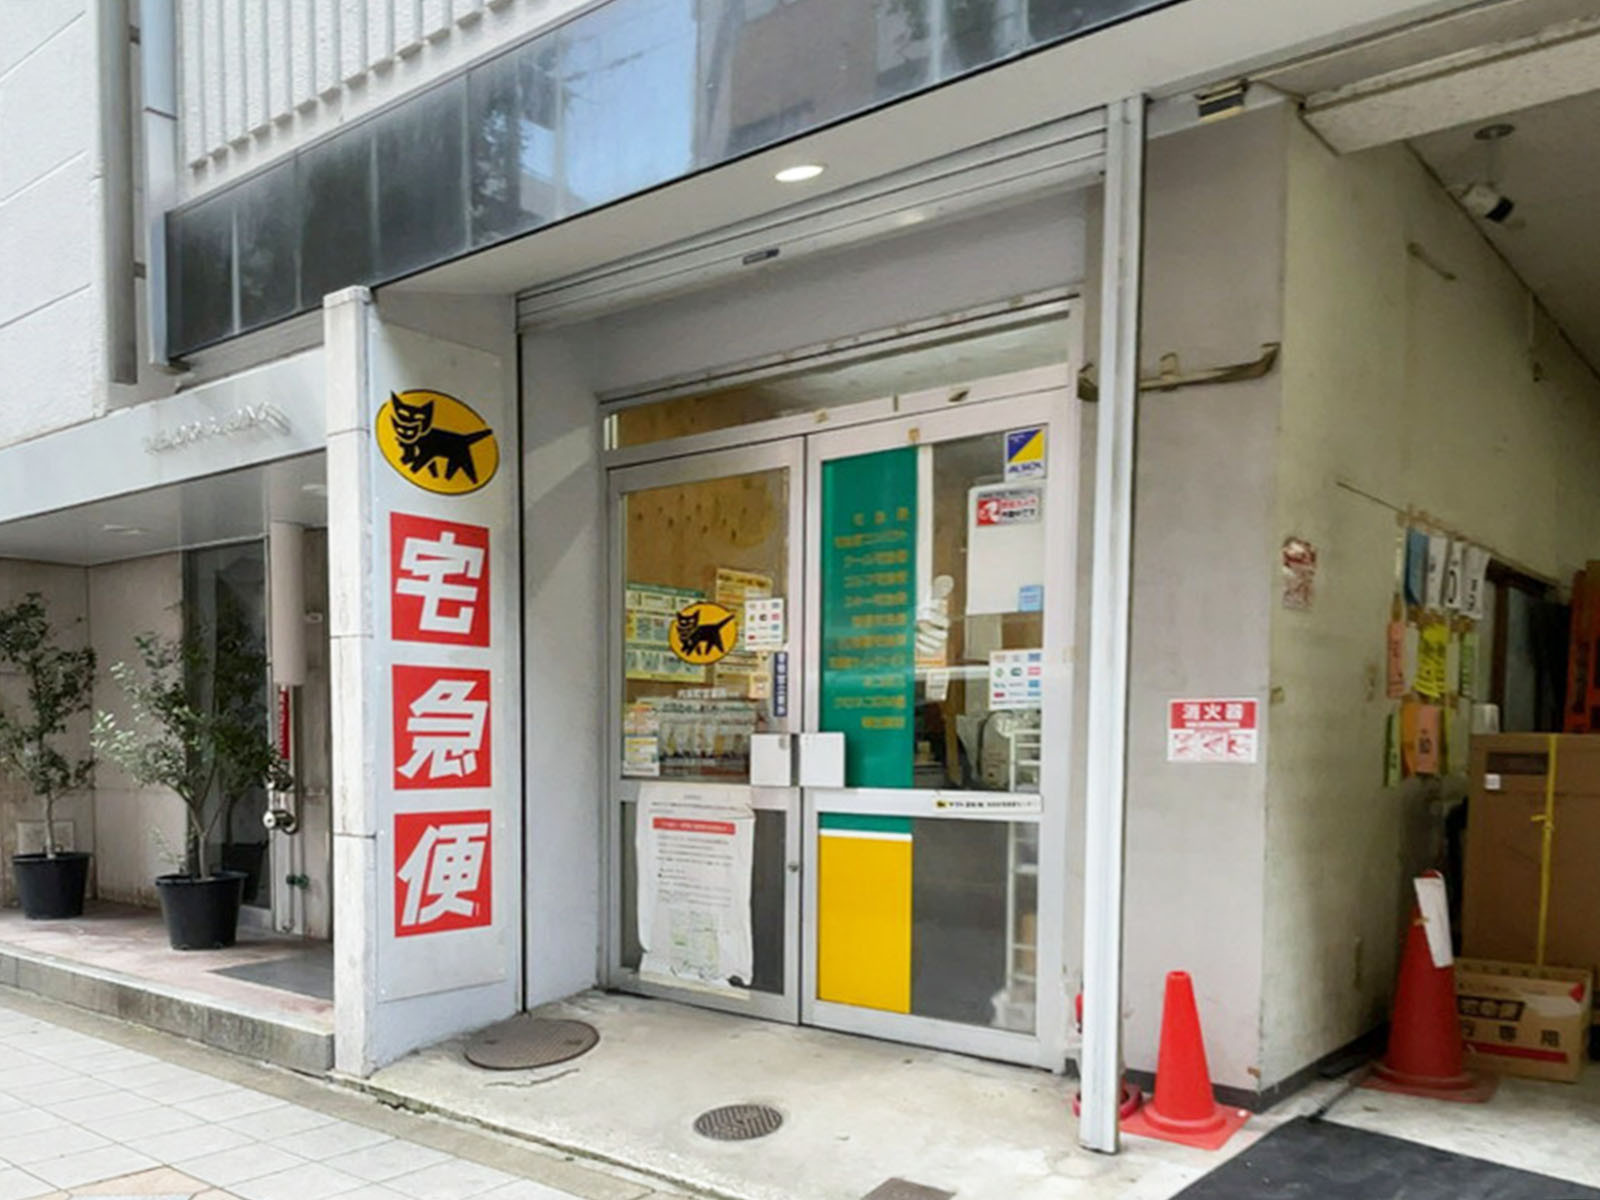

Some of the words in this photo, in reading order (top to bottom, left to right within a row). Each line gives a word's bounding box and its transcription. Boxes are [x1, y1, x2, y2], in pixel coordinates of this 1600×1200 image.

[395, 531, 489, 927] 宅急便
[1181, 703, 1244, 720] 消火器
